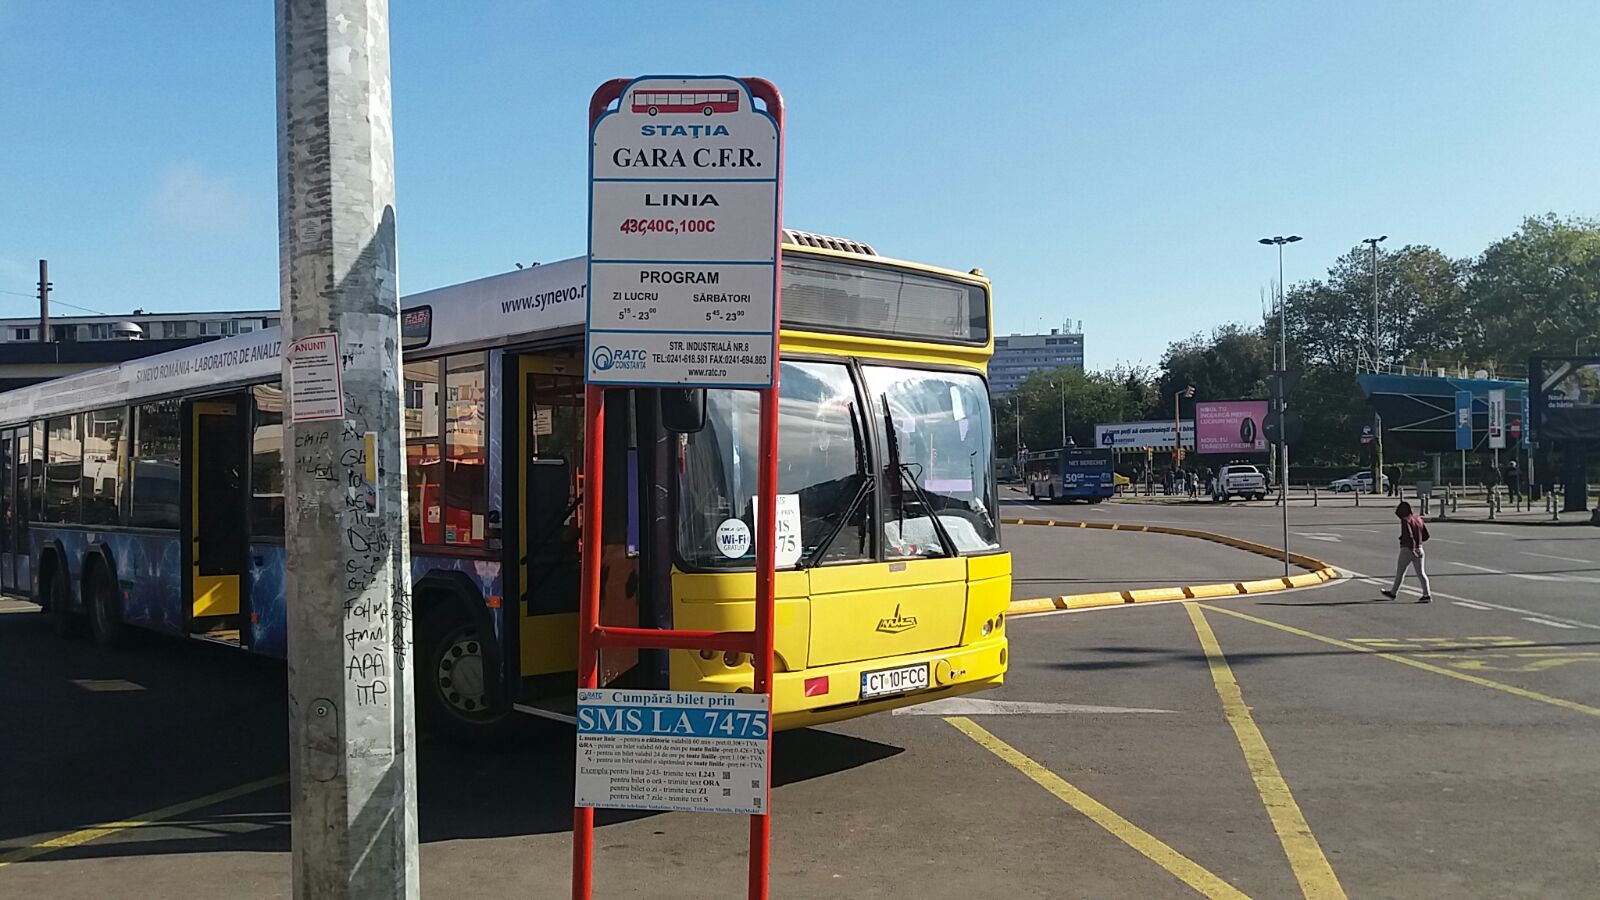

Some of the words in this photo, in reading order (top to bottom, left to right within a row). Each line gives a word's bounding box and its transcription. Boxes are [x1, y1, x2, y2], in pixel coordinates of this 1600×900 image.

[612, 148, 686, 168] GARA
[692, 148, 762, 168] C.F.R.
[645, 194, 720, 207] LINIA
[640, 270, 720, 284] PROGRAM
[612, 292, 622, 300] ZI
[624, 292, 658, 301] LUCRU
[692, 292, 751, 303] SĂRBĂTORI
[669, 342, 684, 351] STR.
[614, 350, 647, 361] RATC
[136, 364, 159, 384] SYNEVO
[194, 350, 238, 373] LABORATOR
[239, 351, 250, 364] DE
[688, 368, 726, 377] www.ratc.ro
[722, 534, 746, 544] Wi-Fi
[870, 674, 885, 690] CT
[890, 672, 900, 688] 10
[901, 668, 925, 686] FCC
[612, 692, 672, 706] Cumpără
[676, 693, 704, 705] bilet
[708, 694, 735, 708] prin
[578, 708, 642, 732] SMS
[652, 710, 694, 734] LA
[704, 712, 767, 736] 7475
